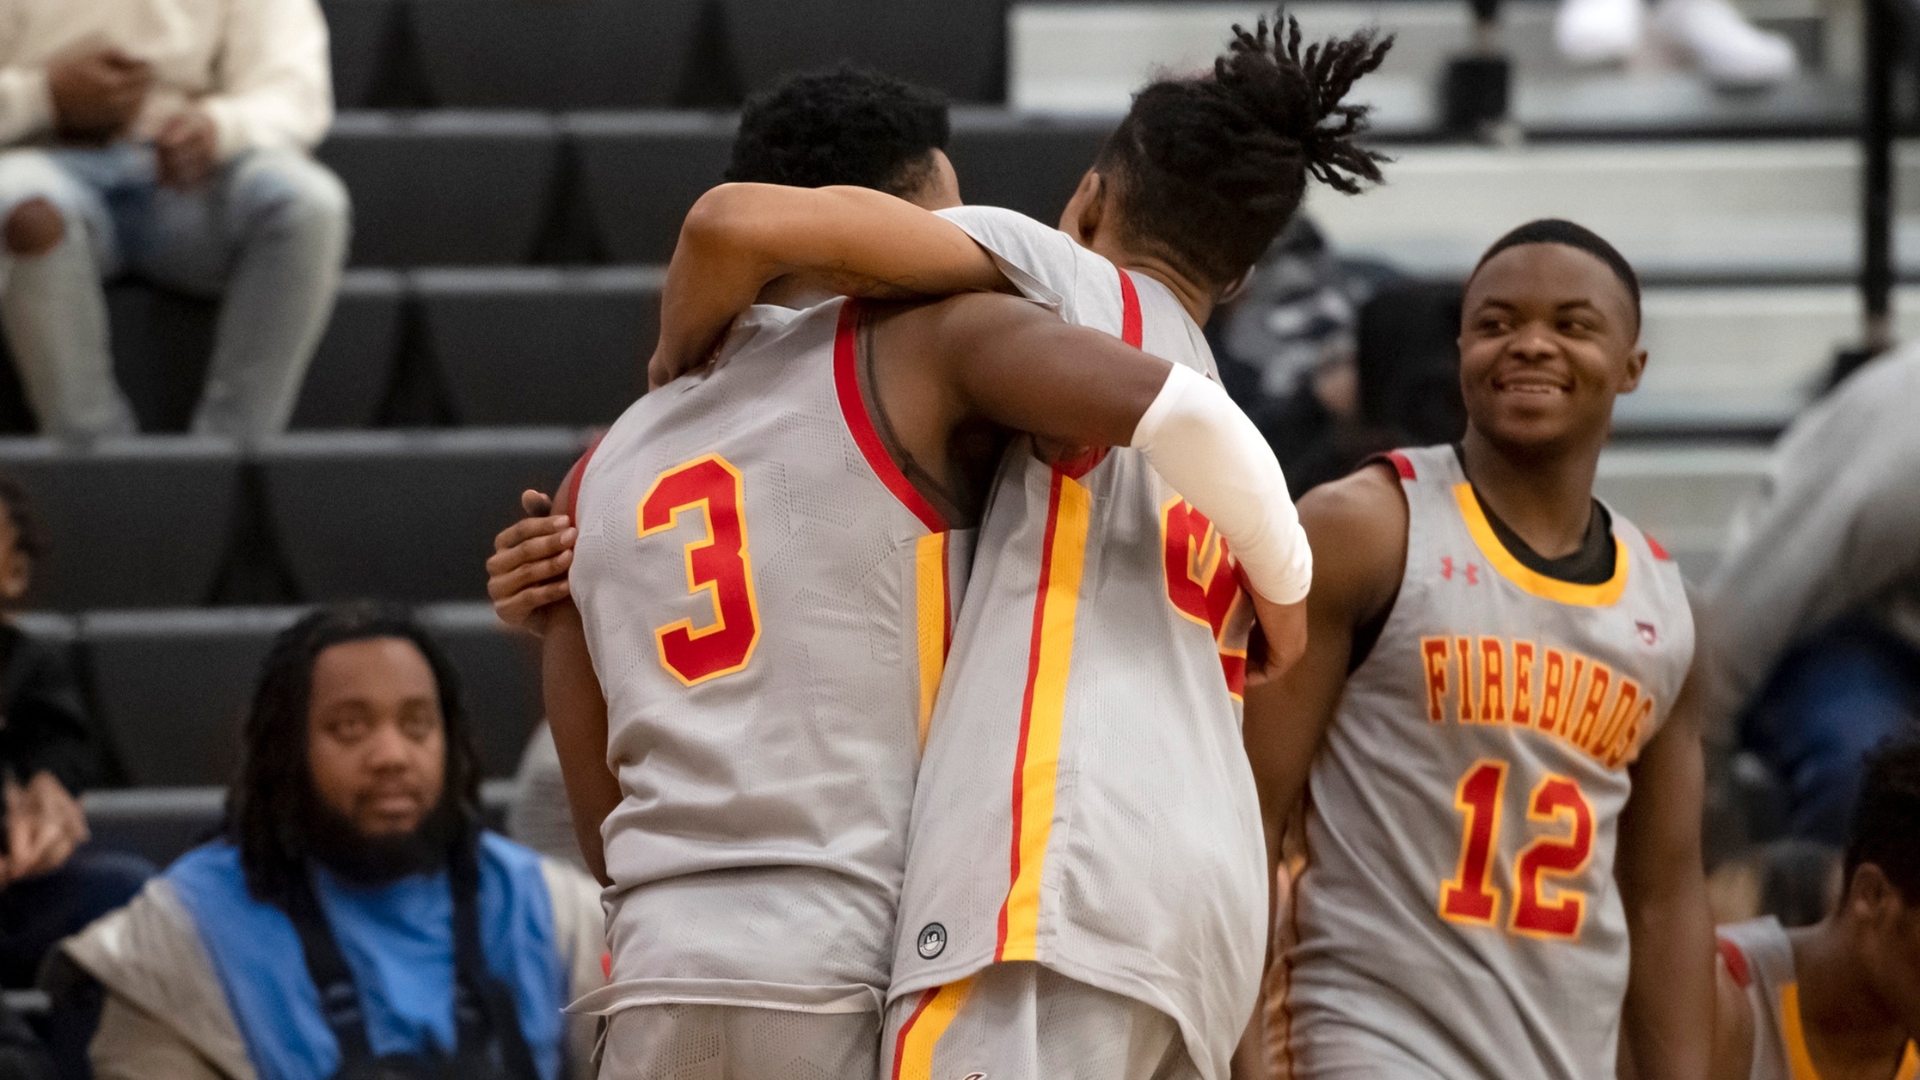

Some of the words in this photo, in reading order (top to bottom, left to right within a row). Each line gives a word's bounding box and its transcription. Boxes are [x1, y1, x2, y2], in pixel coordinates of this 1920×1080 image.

[637, 452, 761, 687] 3
[1421, 635, 1655, 770] FIREBIRDS
[1438, 757, 1595, 939] 12
